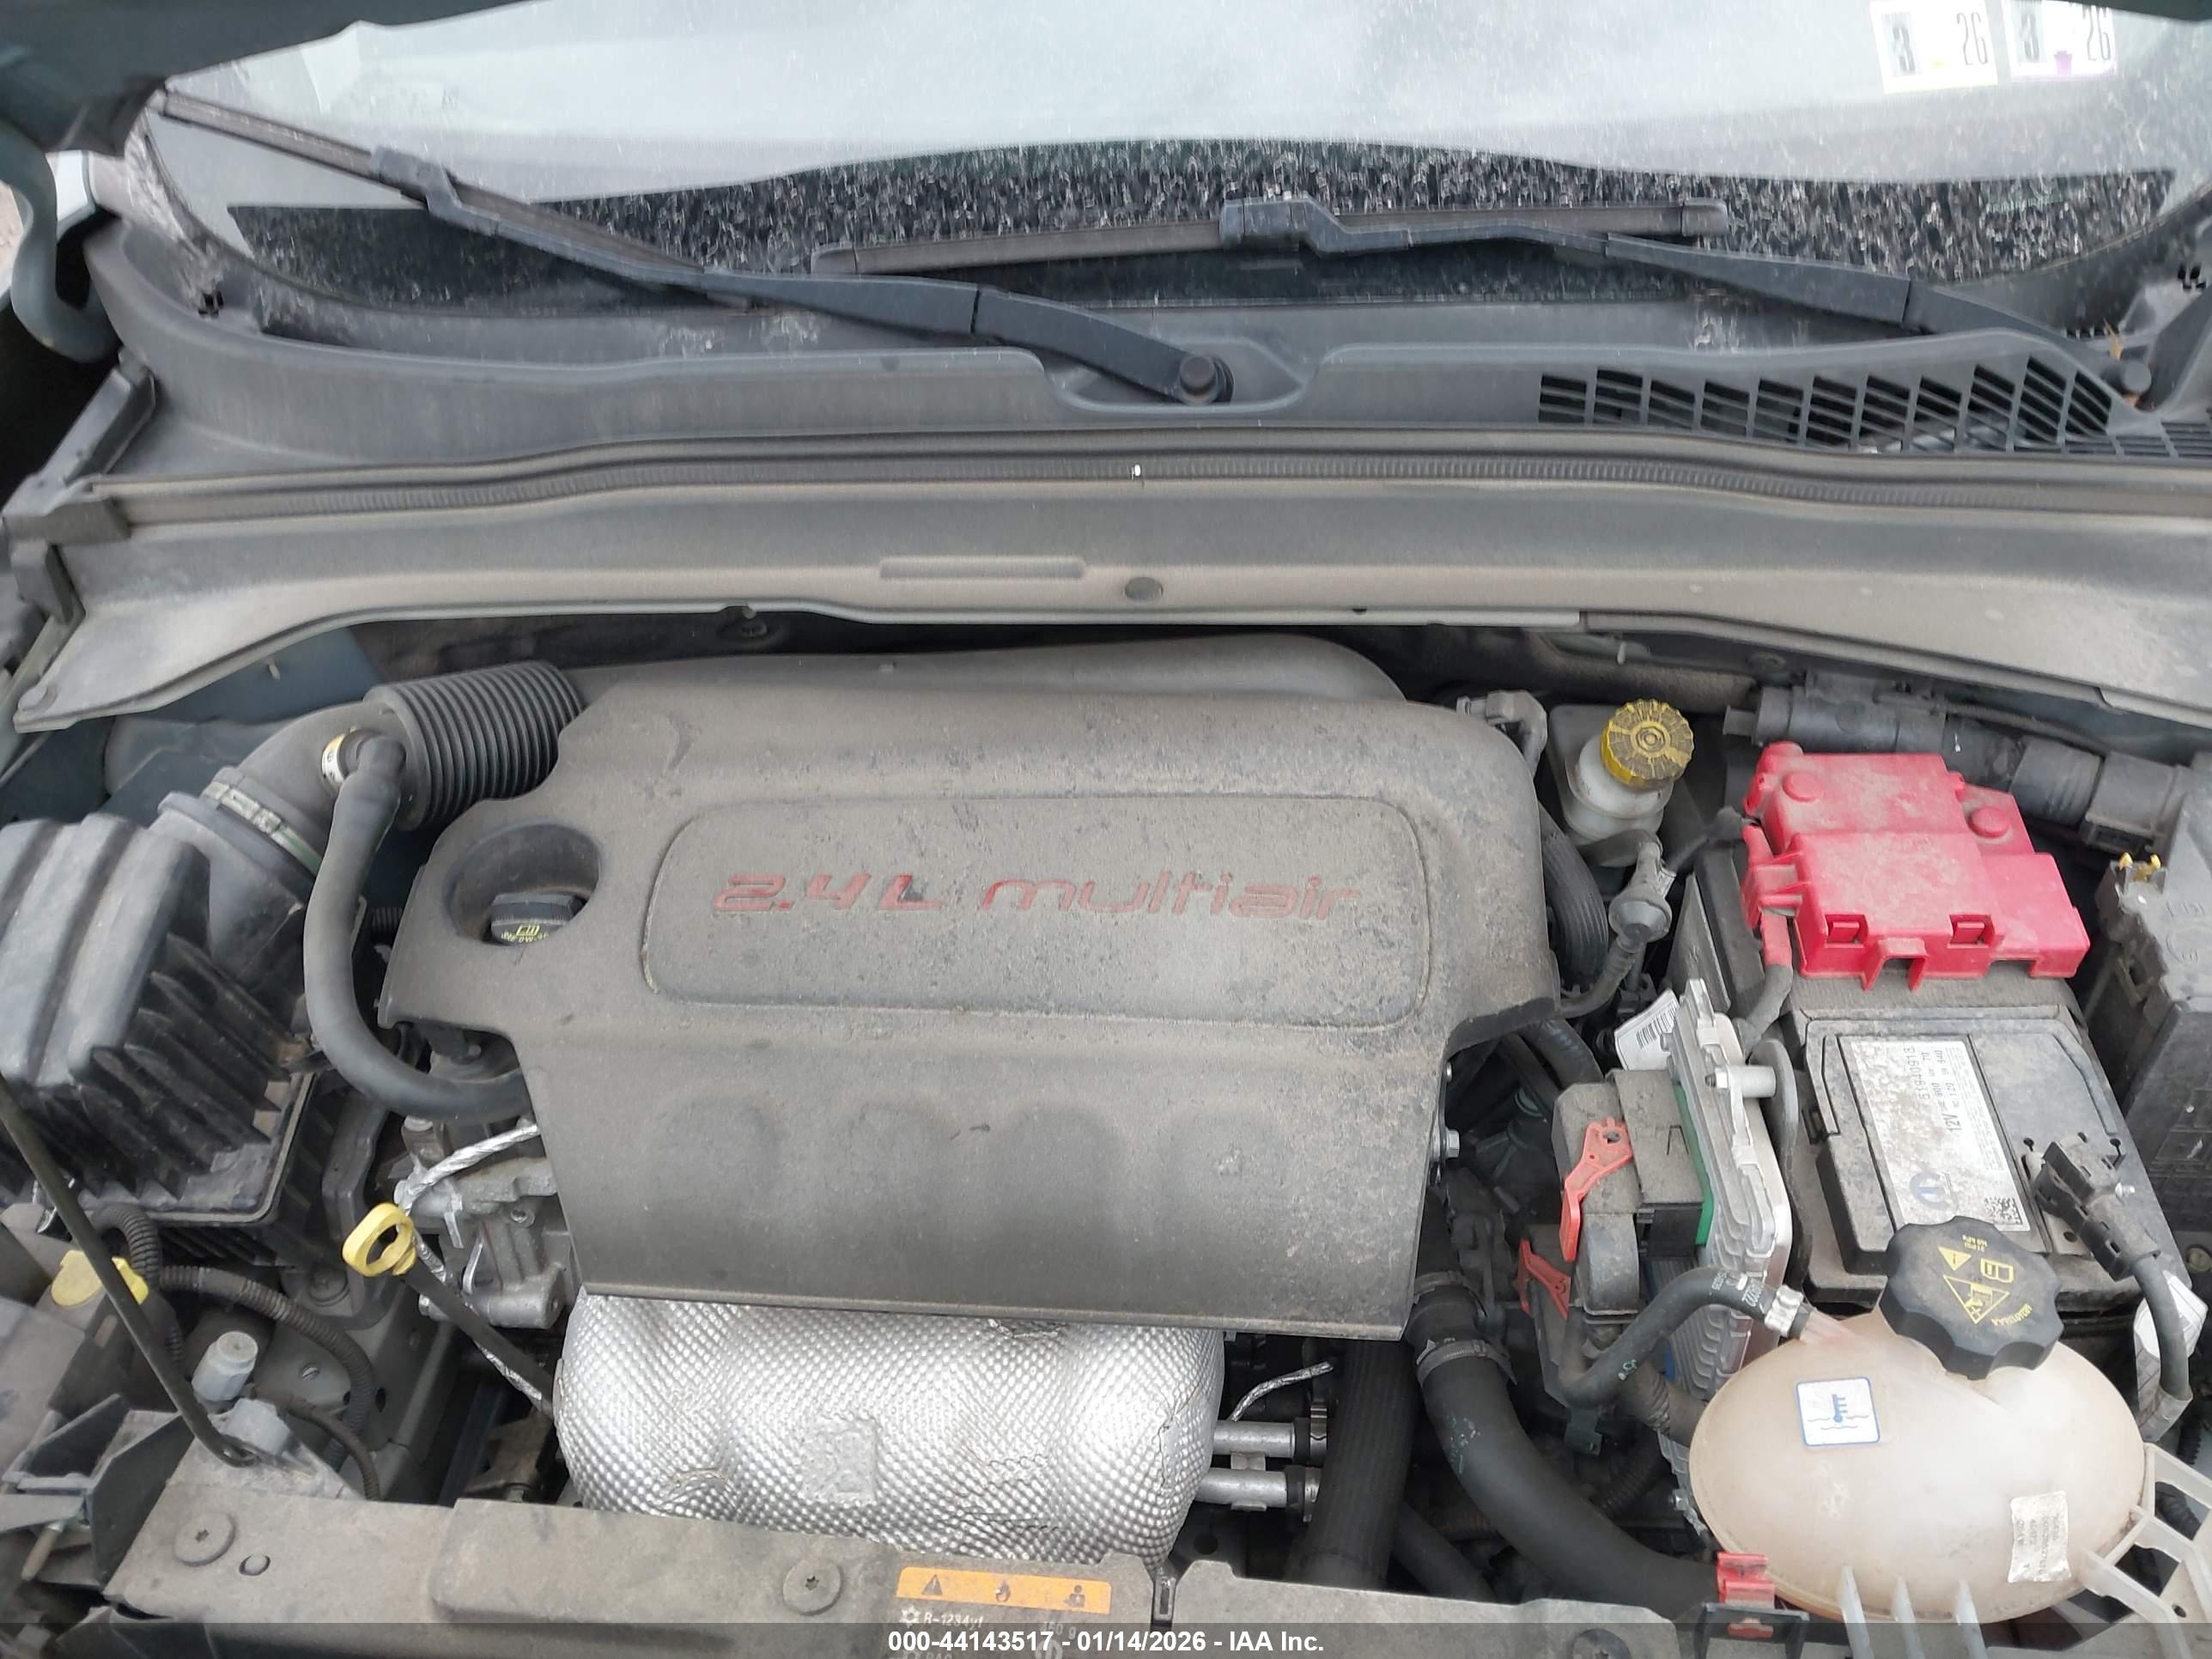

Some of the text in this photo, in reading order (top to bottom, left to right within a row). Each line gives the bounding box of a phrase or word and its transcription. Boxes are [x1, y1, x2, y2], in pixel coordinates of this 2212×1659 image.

[1956, 11, 1990, 66] 26
[2081, 5, 2112, 62] 26
[979, 869, 1361, 921] multiair
[1941, 1113, 1963, 1132] 12V
